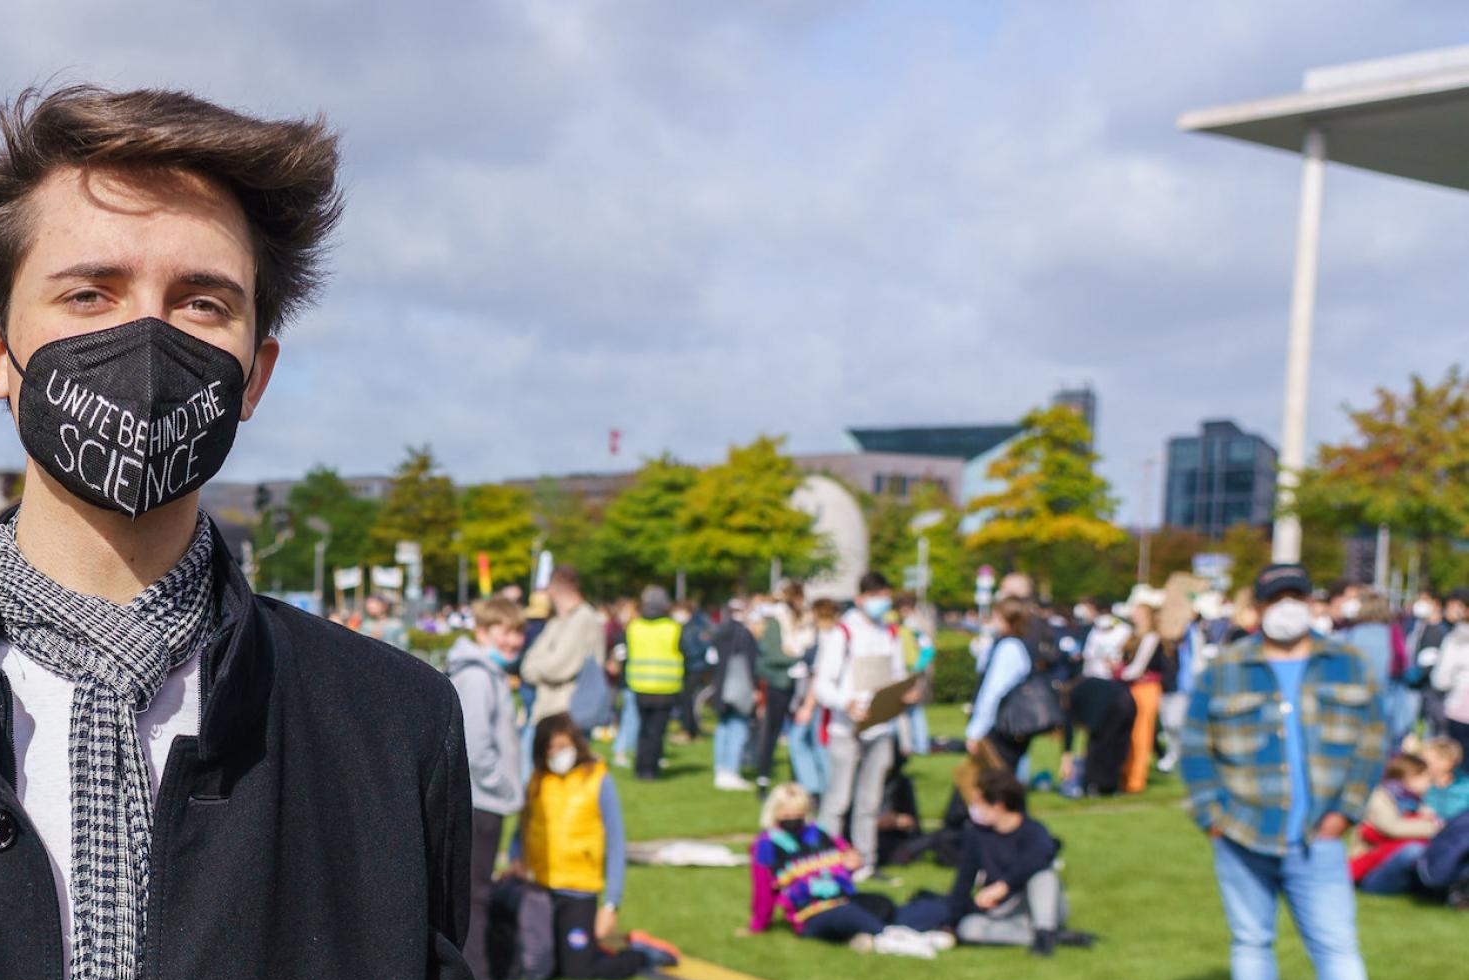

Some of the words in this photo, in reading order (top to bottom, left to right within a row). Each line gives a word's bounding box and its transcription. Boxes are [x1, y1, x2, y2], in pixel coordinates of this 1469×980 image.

[46, 369, 119, 440] UNITE
[117, 407, 189, 456] BEHIND
[187, 380, 225, 429] THE
[54, 423, 207, 514] SCIENCE
